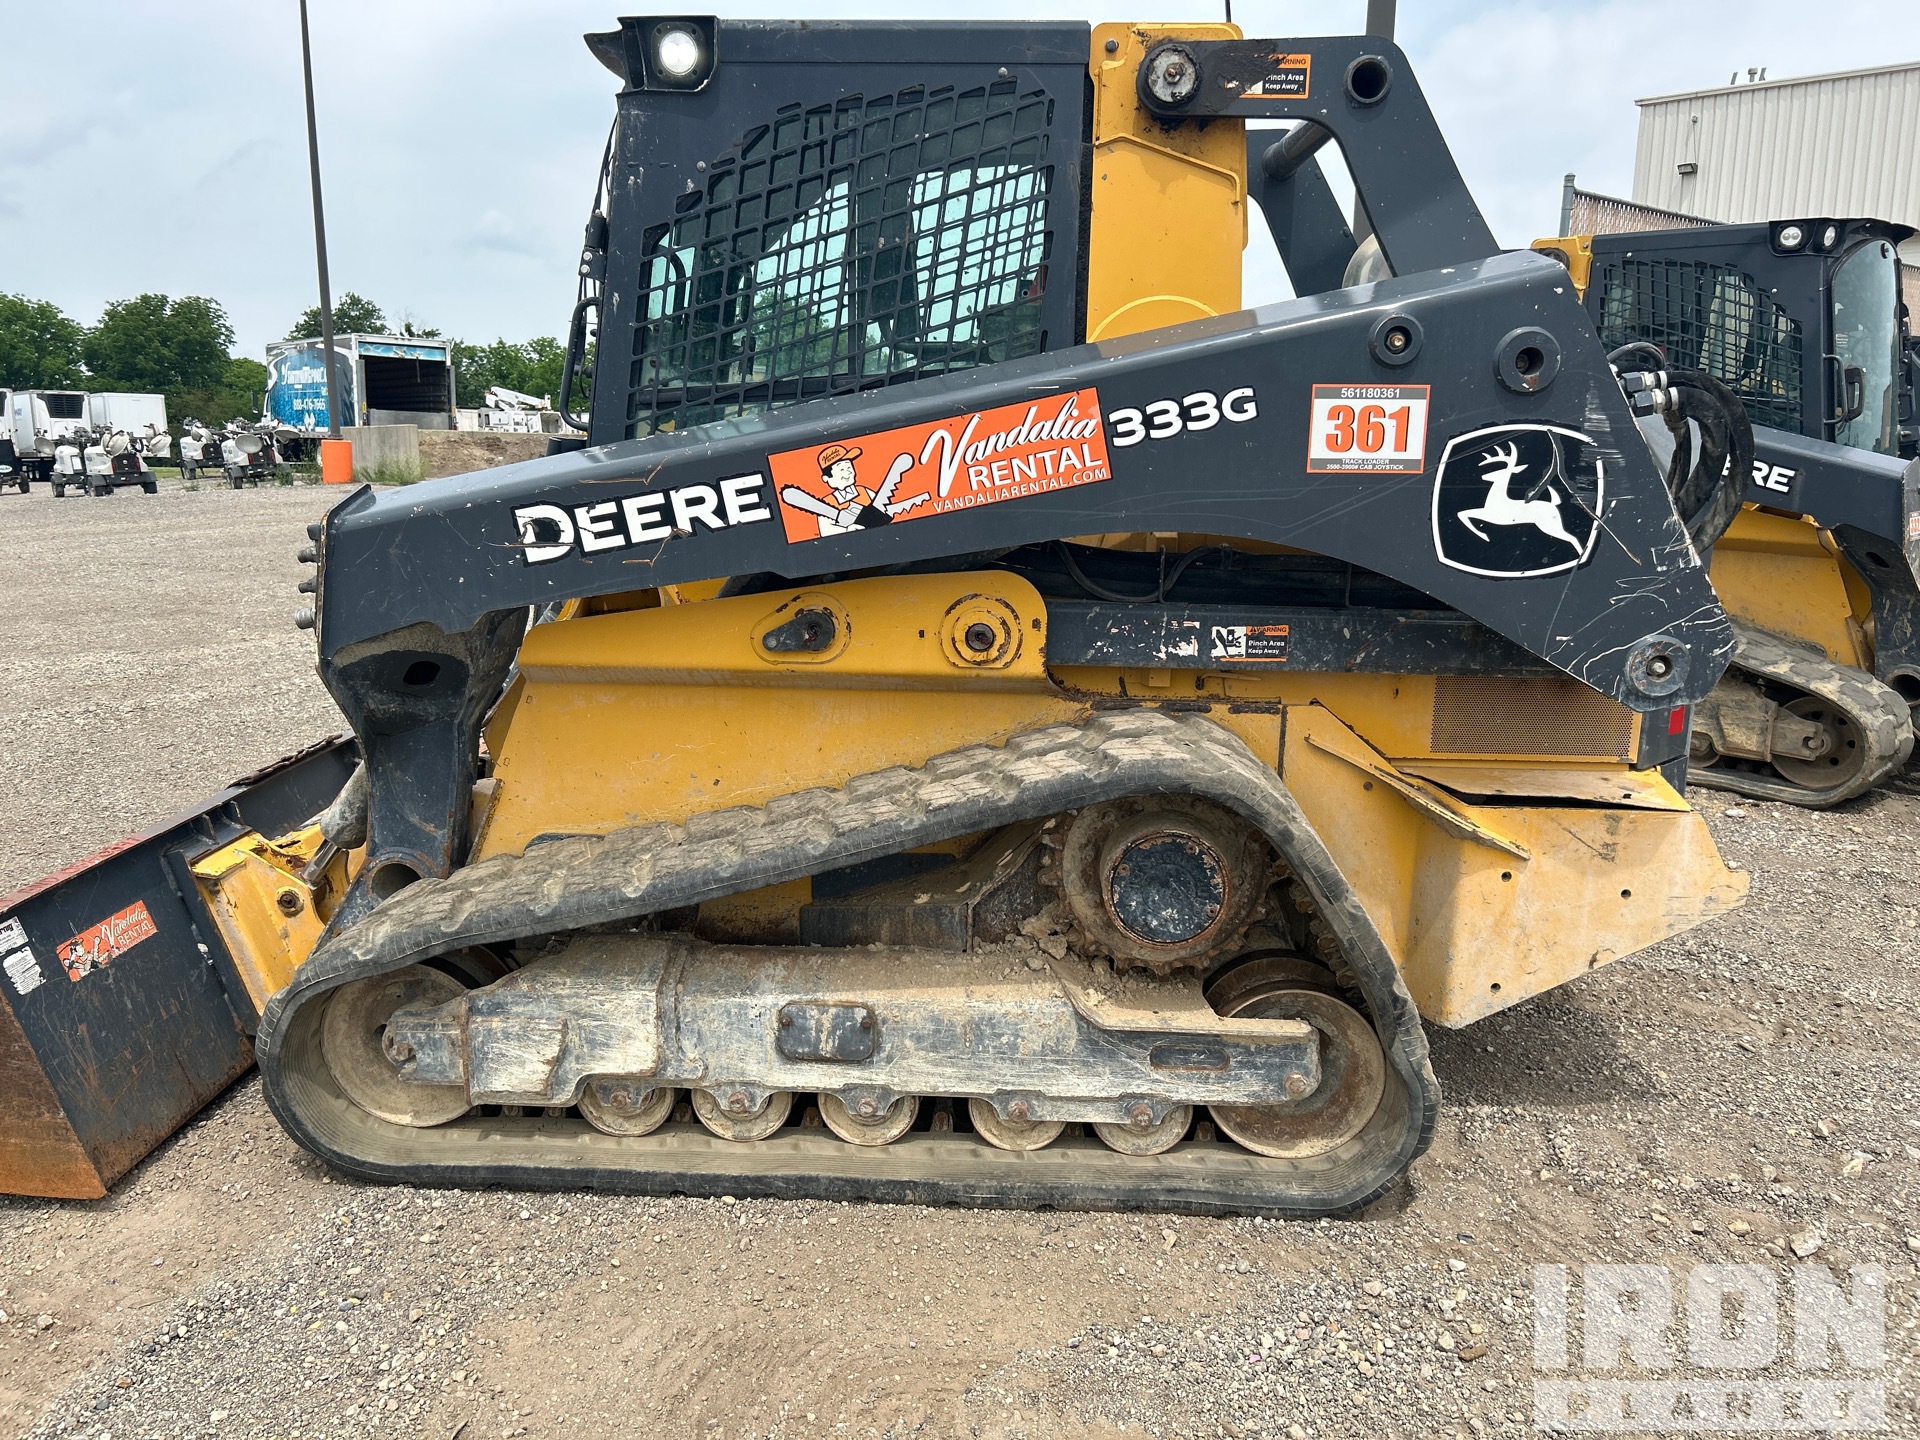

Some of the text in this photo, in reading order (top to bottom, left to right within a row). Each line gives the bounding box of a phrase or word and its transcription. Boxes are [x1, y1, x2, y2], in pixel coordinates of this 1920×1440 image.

[1277, 58, 1307, 66] ARNING
[1286, 73, 1304, 81] Area
[1265, 83, 1299, 91] Keep Away
[1340, 387, 1401, 399] 561180361
[1108, 387, 1258, 447] 333G
[1325, 404, 1411, 453] 361
[918, 396, 1098, 498] Vandalia
[967, 442, 1103, 492] RENTAL
[1373, 463, 1404, 471] JOYSTICK
[932, 467, 1107, 513] VANDALIARENTAL.COM
[514, 473, 772, 563] DEERE
[116, 919, 154, 946] RENTAL
